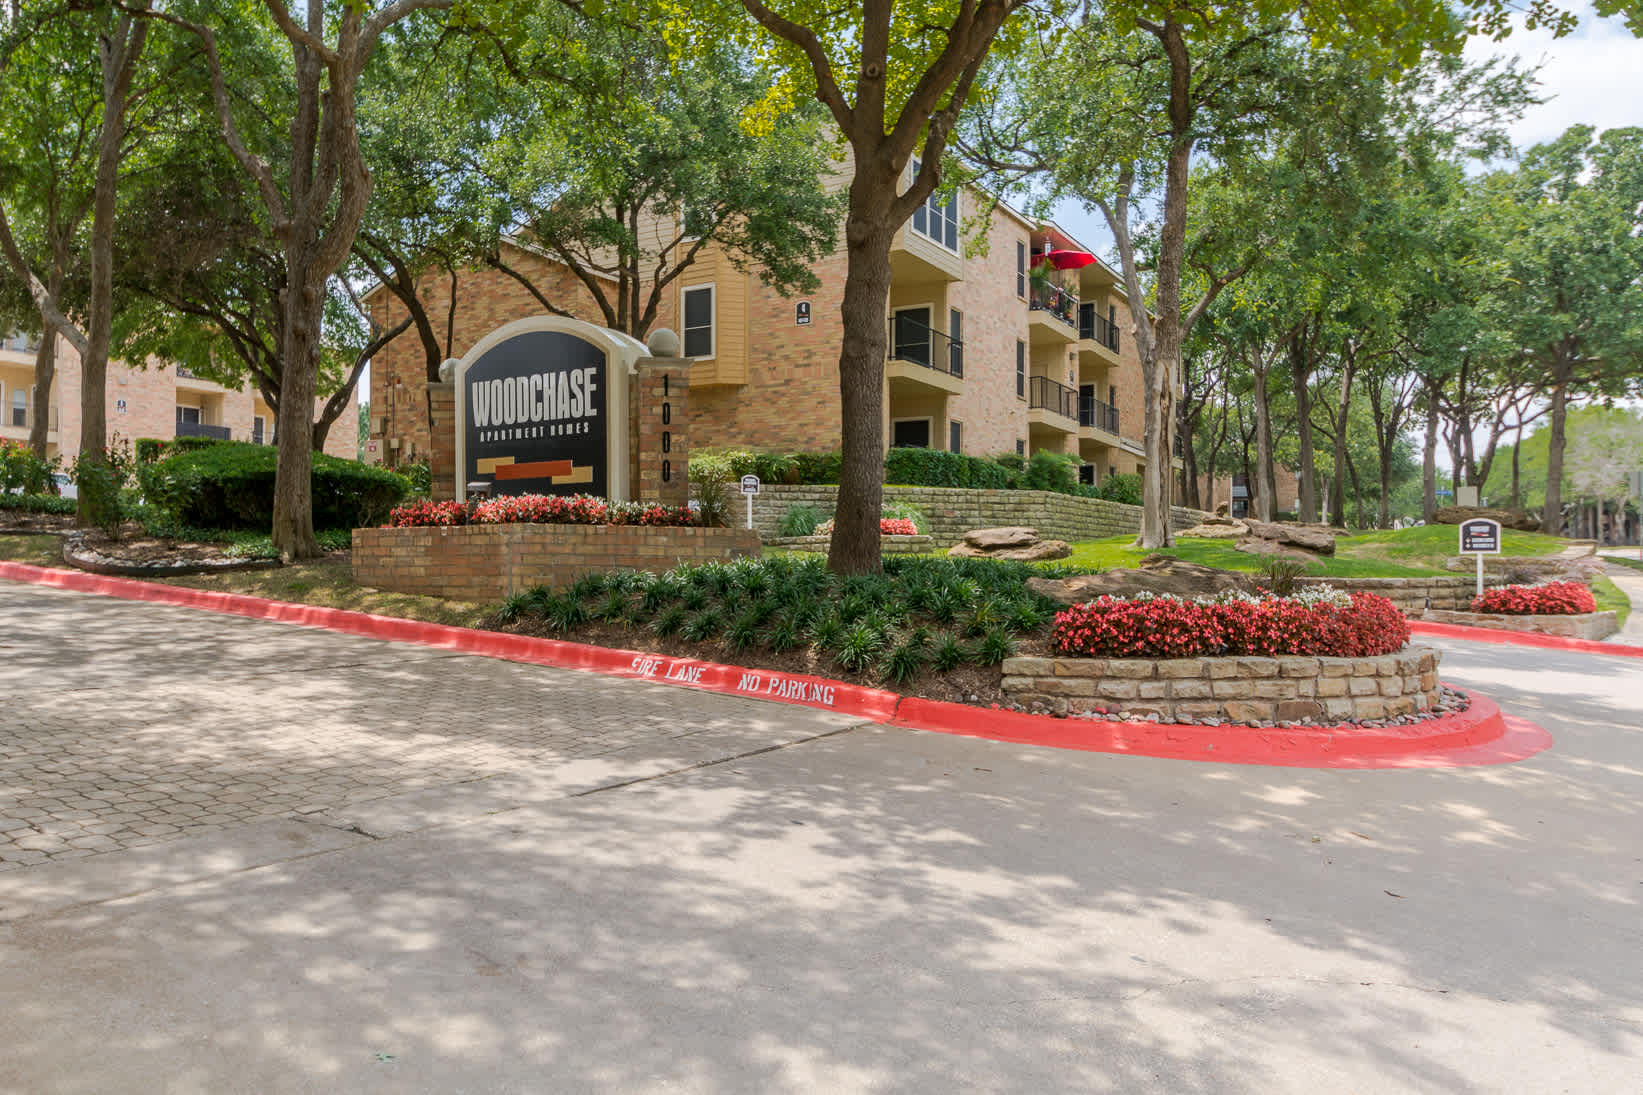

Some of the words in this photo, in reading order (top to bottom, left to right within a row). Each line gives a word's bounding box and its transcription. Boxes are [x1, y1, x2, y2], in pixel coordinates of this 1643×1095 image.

[472, 367, 597, 427] WOODCHASE
[480, 427, 545, 442] APARTMENT
[551, 422, 589, 437] HOMES
[662, 374, 671, 482] 1000
[629, 656, 662, 677] FIRE
[664, 663, 706, 685] LANE
[737, 673, 761, 692] NO
[767, 677, 835, 705] PARKING
